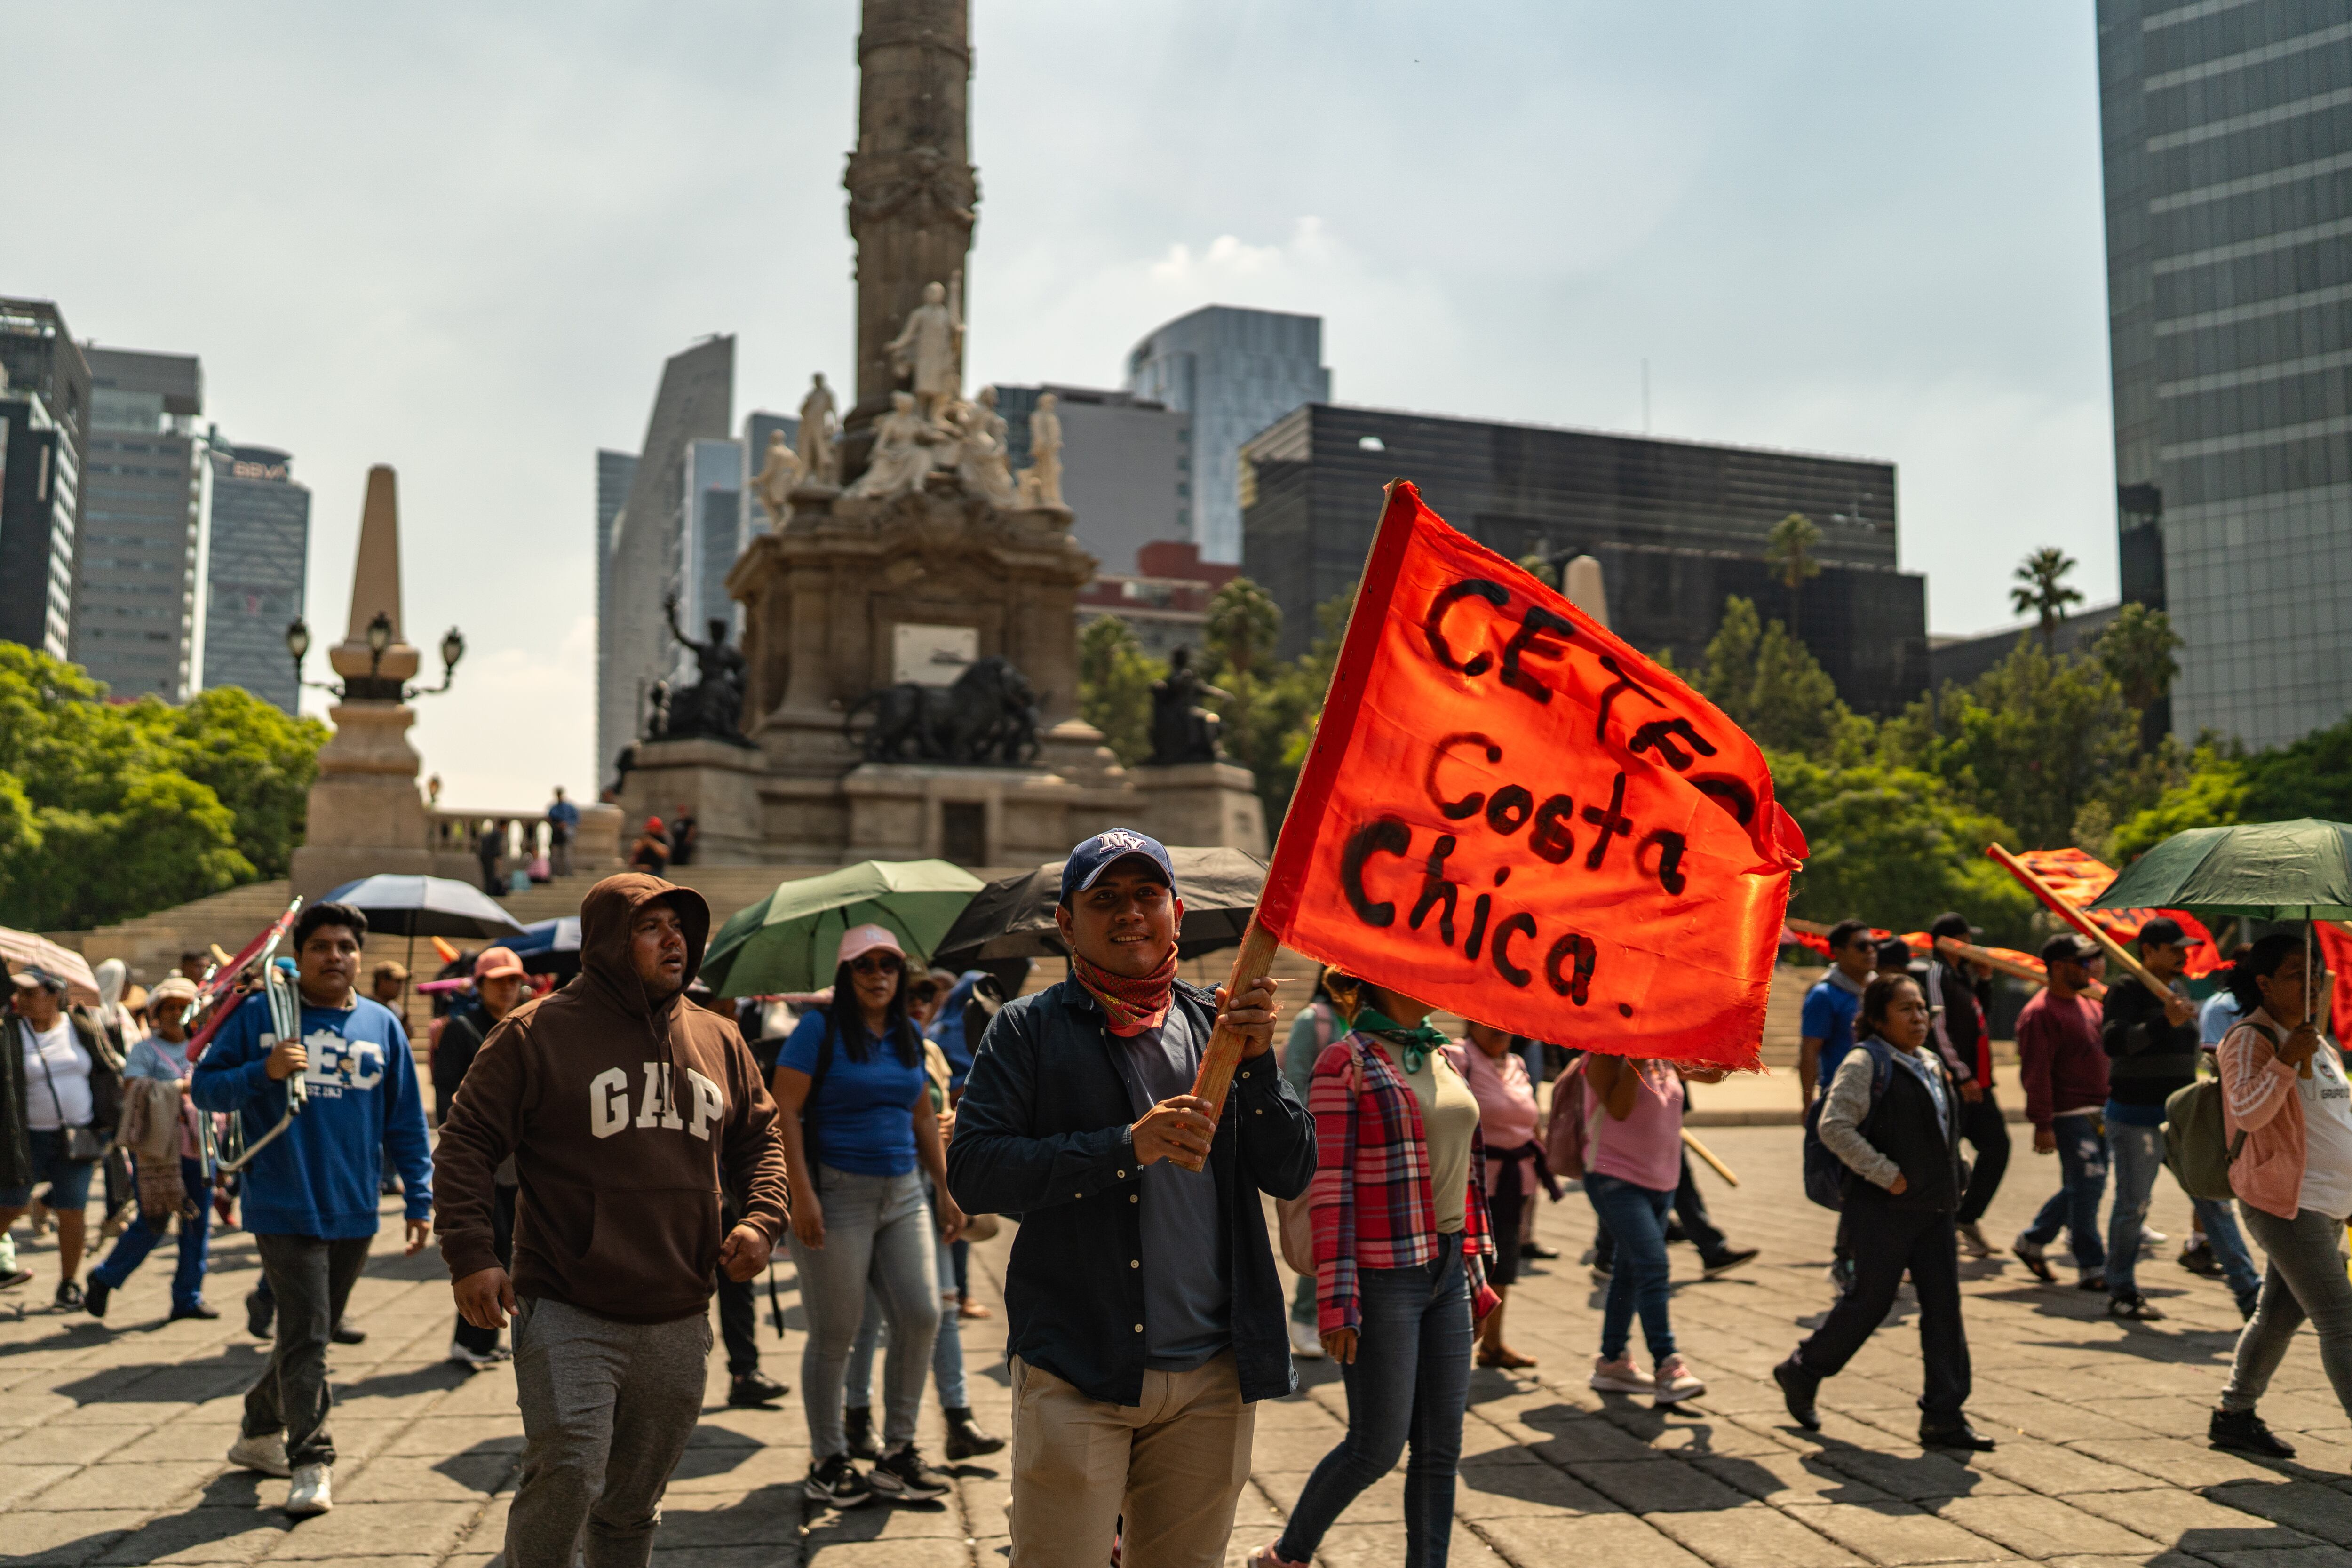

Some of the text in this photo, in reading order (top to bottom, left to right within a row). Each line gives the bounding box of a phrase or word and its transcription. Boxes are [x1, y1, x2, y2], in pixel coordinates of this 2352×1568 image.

[1098, 832, 1147, 854] NY
[1424, 731, 1688, 896] Costa
[1341, 814, 1634, 1018] Chica.
[260, 1032, 385, 1090] EC
[590, 1062, 723, 1142] GAP
